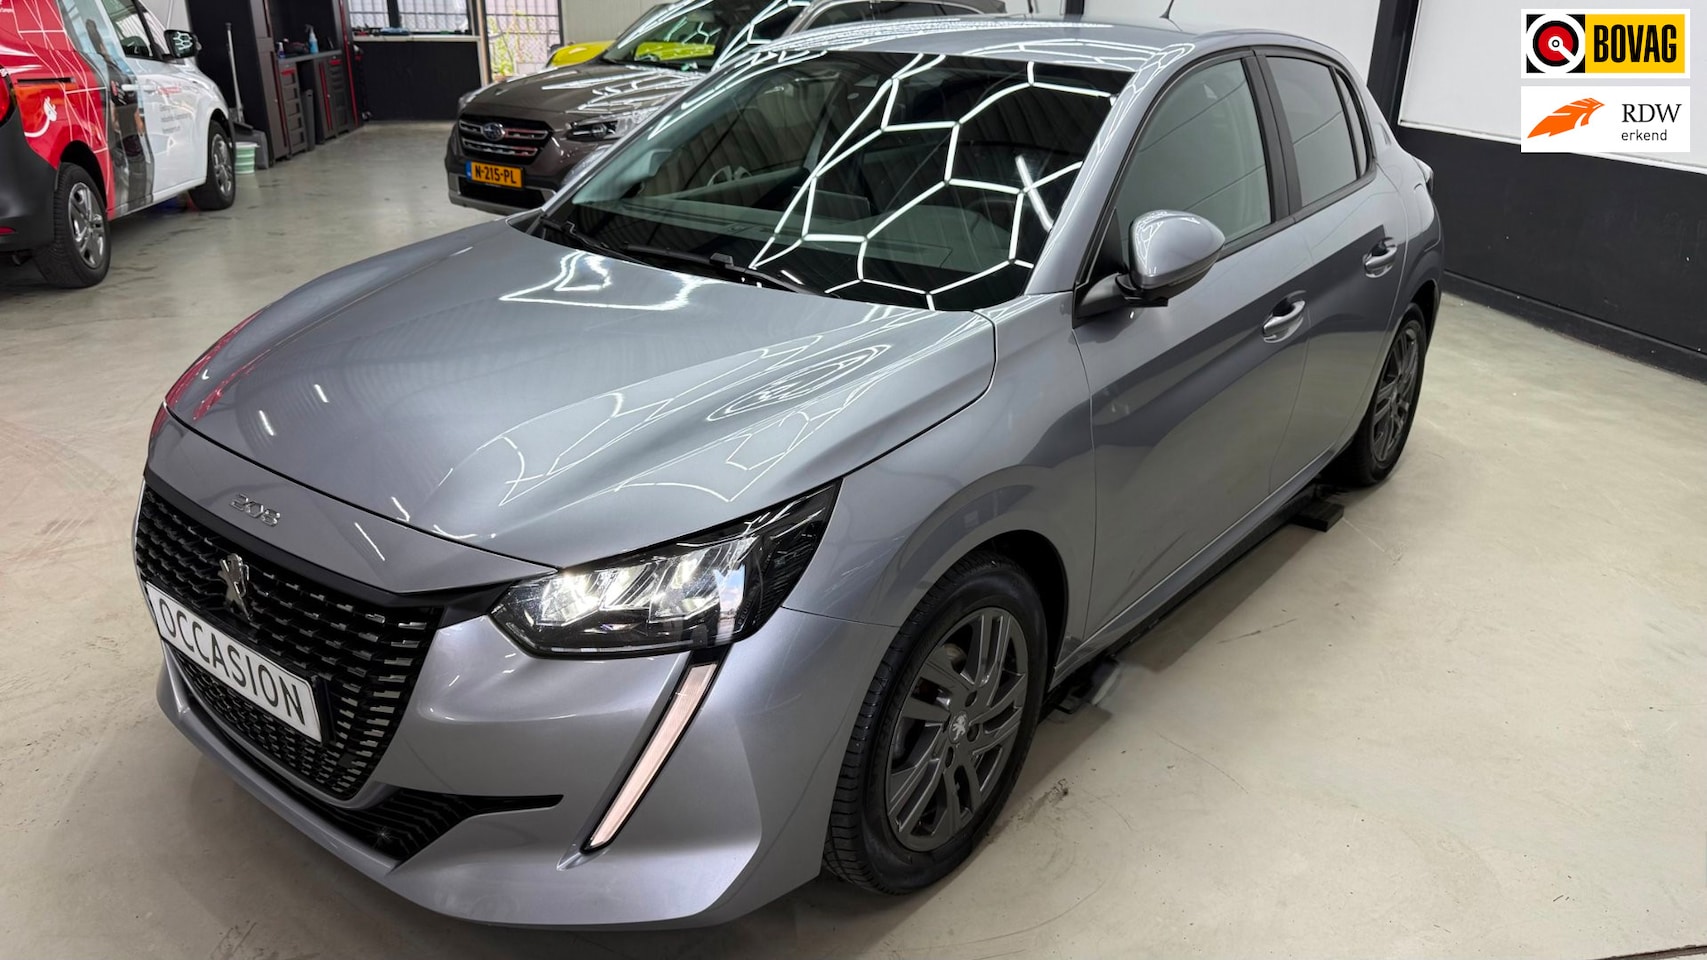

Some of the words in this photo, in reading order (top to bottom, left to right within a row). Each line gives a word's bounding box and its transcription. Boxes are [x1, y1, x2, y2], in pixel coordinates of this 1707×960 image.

[474, 164, 517, 184] N-215-PL
[231, 493, 281, 527] 208
[159, 598, 306, 726] OCCASION
